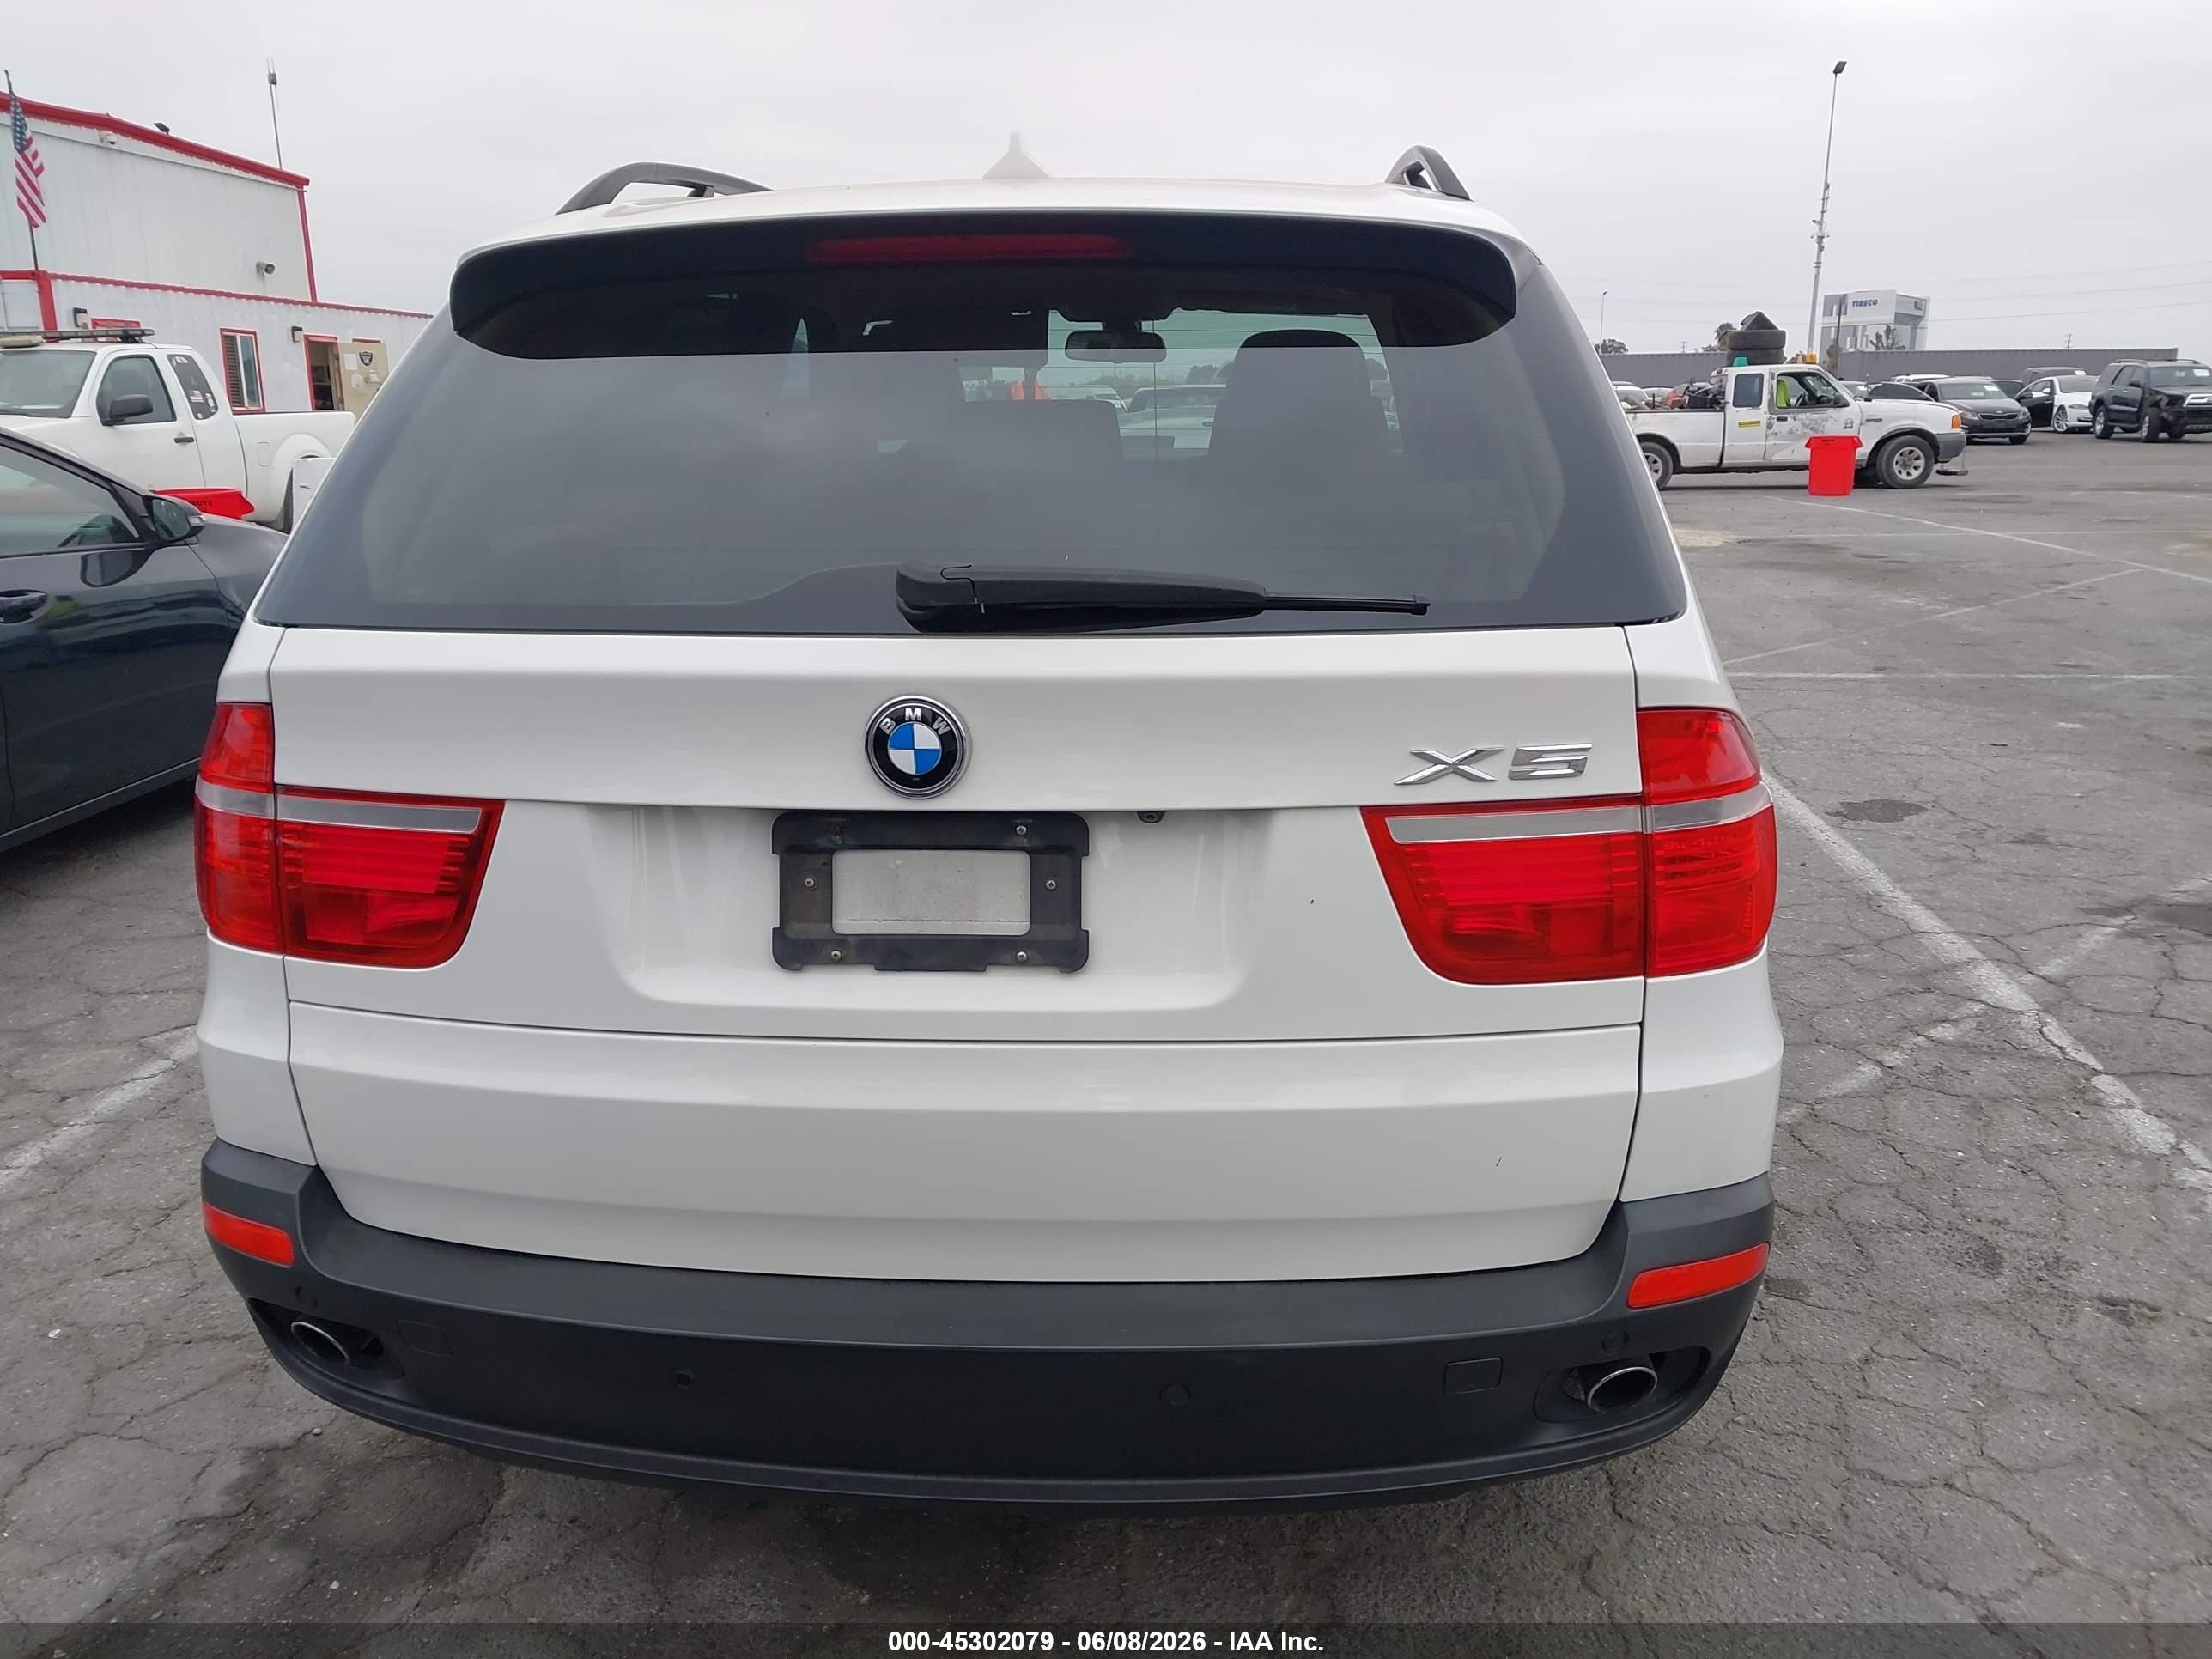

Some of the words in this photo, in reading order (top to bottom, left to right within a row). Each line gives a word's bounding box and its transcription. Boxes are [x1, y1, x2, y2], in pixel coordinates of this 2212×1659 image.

[1852, 298, 1878, 307] TIRECO
[879, 708, 951, 735] BMW
[1394, 743, 1593, 786] X5
